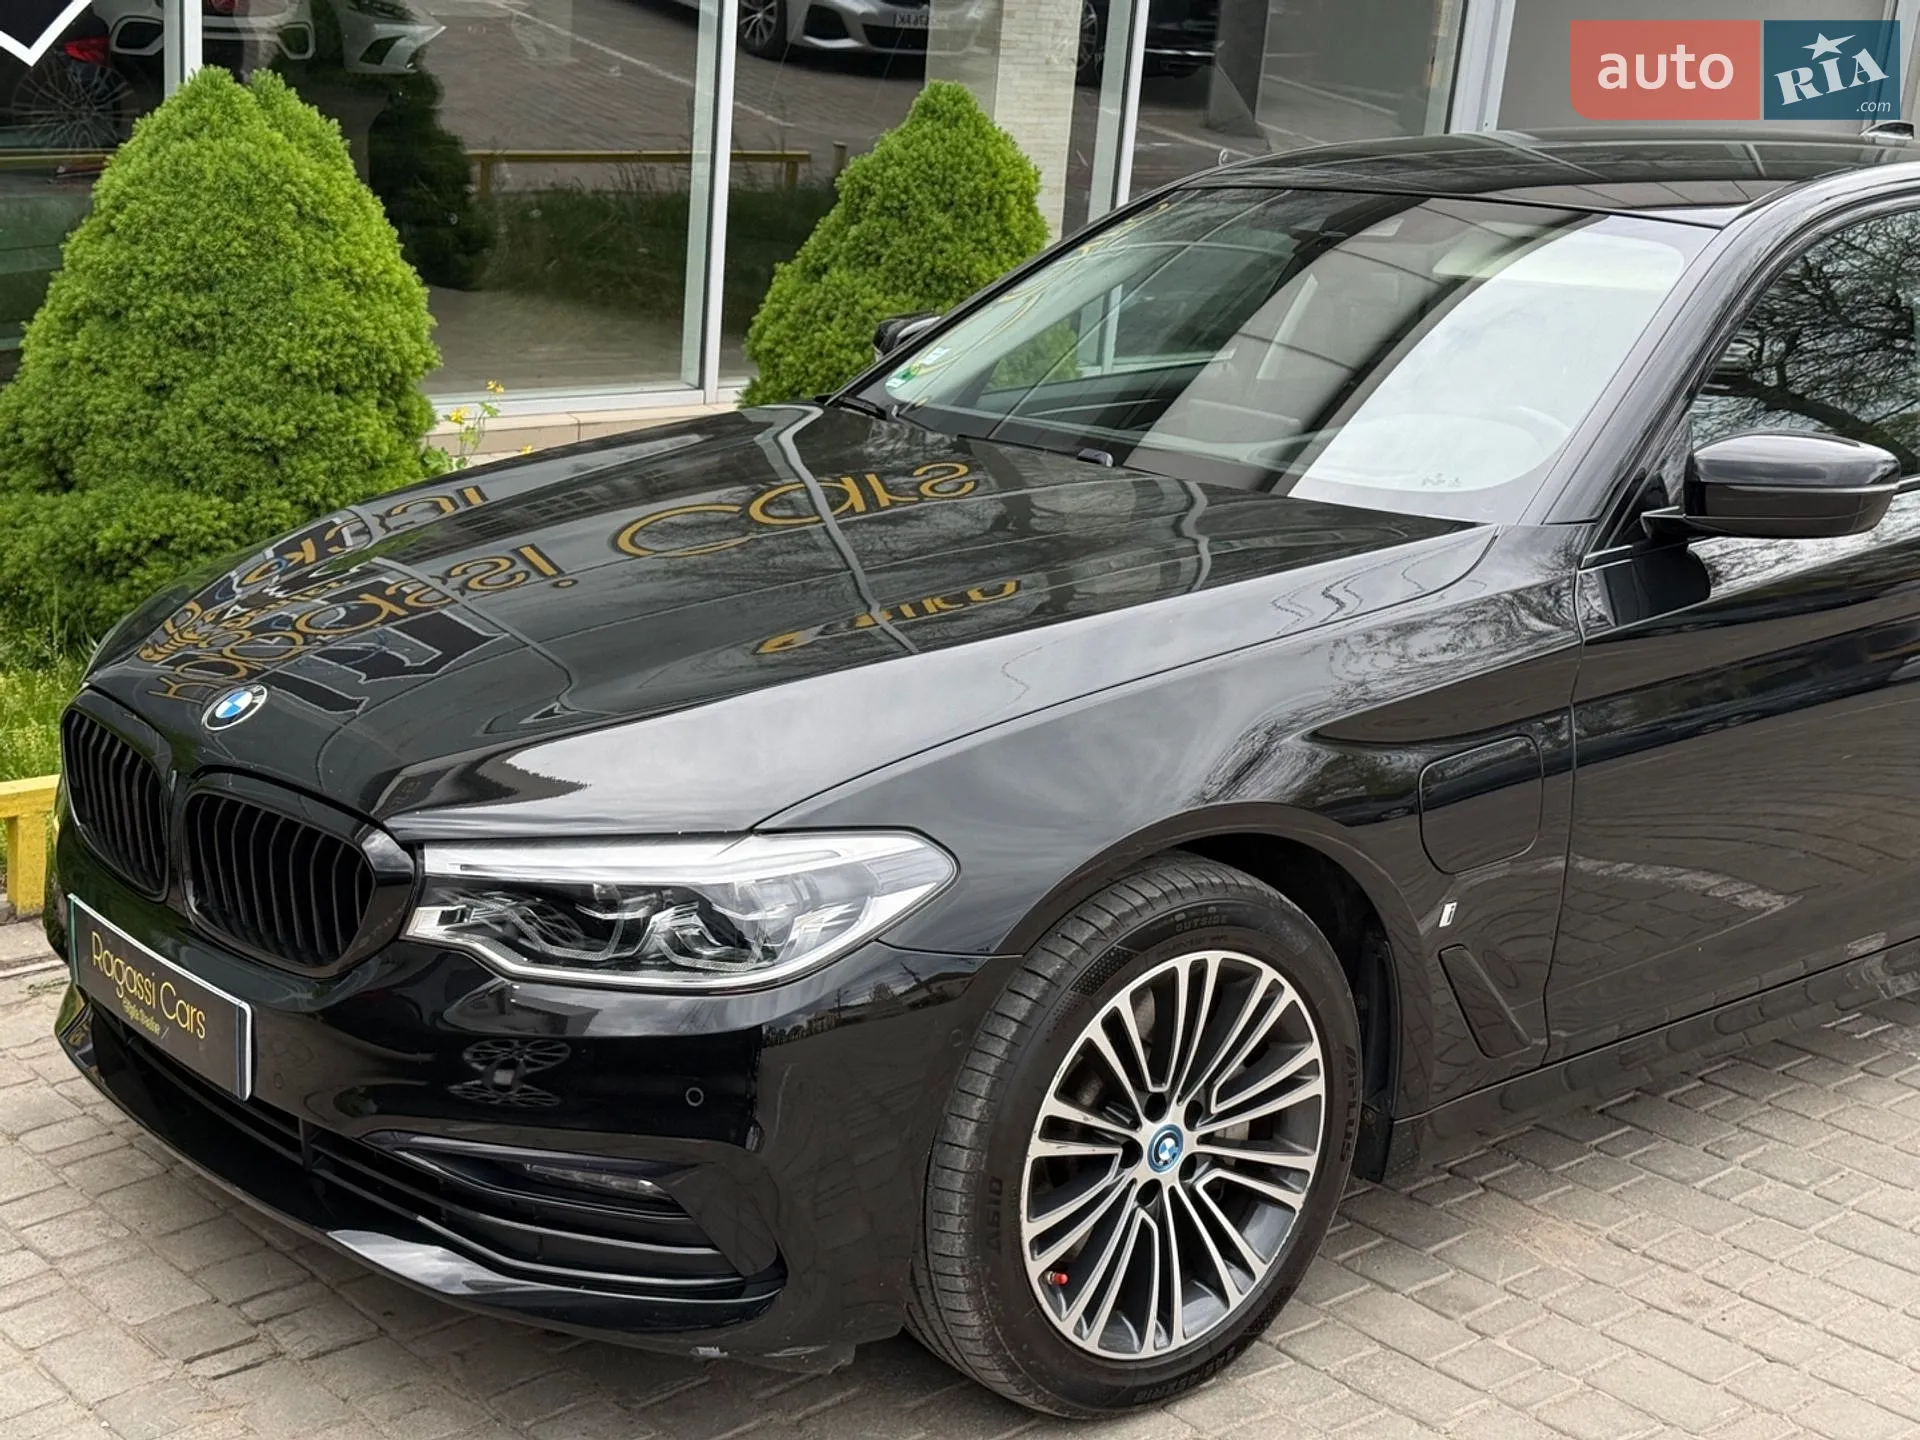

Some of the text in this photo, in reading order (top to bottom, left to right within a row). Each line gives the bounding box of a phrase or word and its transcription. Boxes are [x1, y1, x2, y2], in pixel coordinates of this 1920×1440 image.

[1175, 914, 1229, 932] OUTSIDE
[92, 930, 206, 1039] Ragassi Cars
